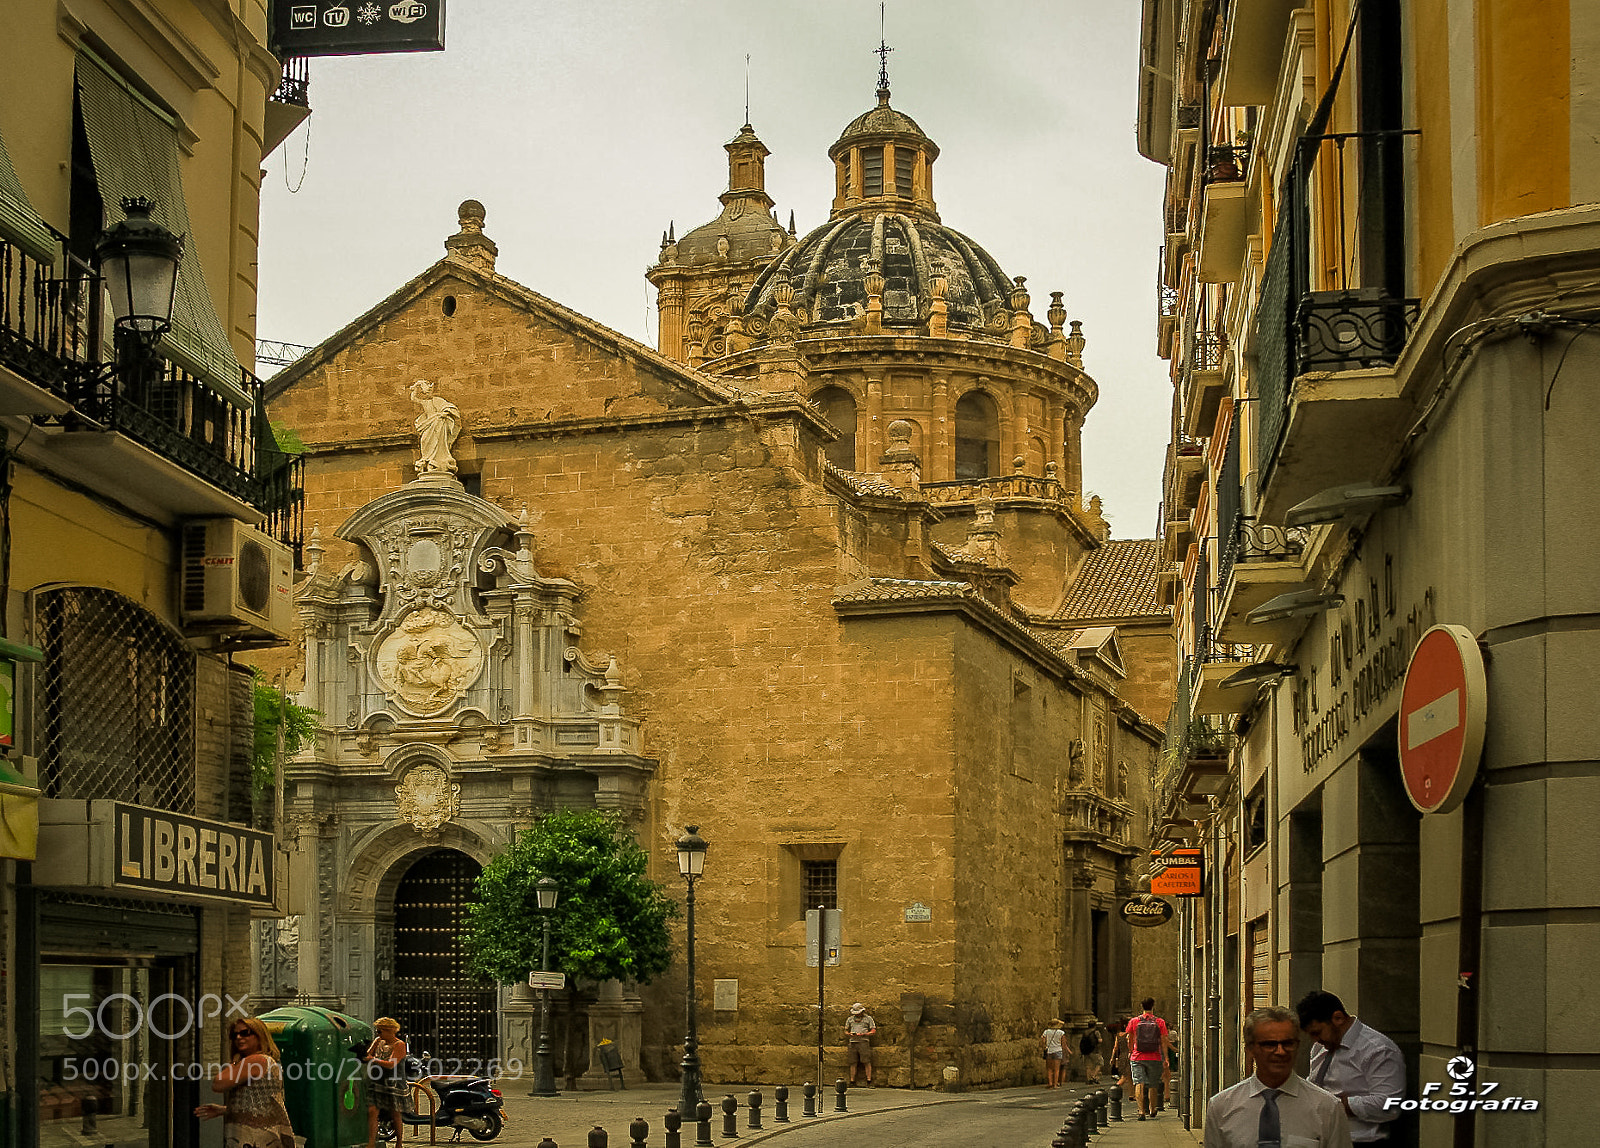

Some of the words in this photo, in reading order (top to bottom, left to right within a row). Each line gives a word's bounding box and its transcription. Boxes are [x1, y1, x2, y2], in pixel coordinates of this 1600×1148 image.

[293, 12, 314, 24] WC
[326, 12, 344, 24] TV
[121, 812, 267, 896] LIBRERIA
[1159, 872, 1189, 880] CARLOS
[1157, 881, 1196, 889] CAFETERIA
